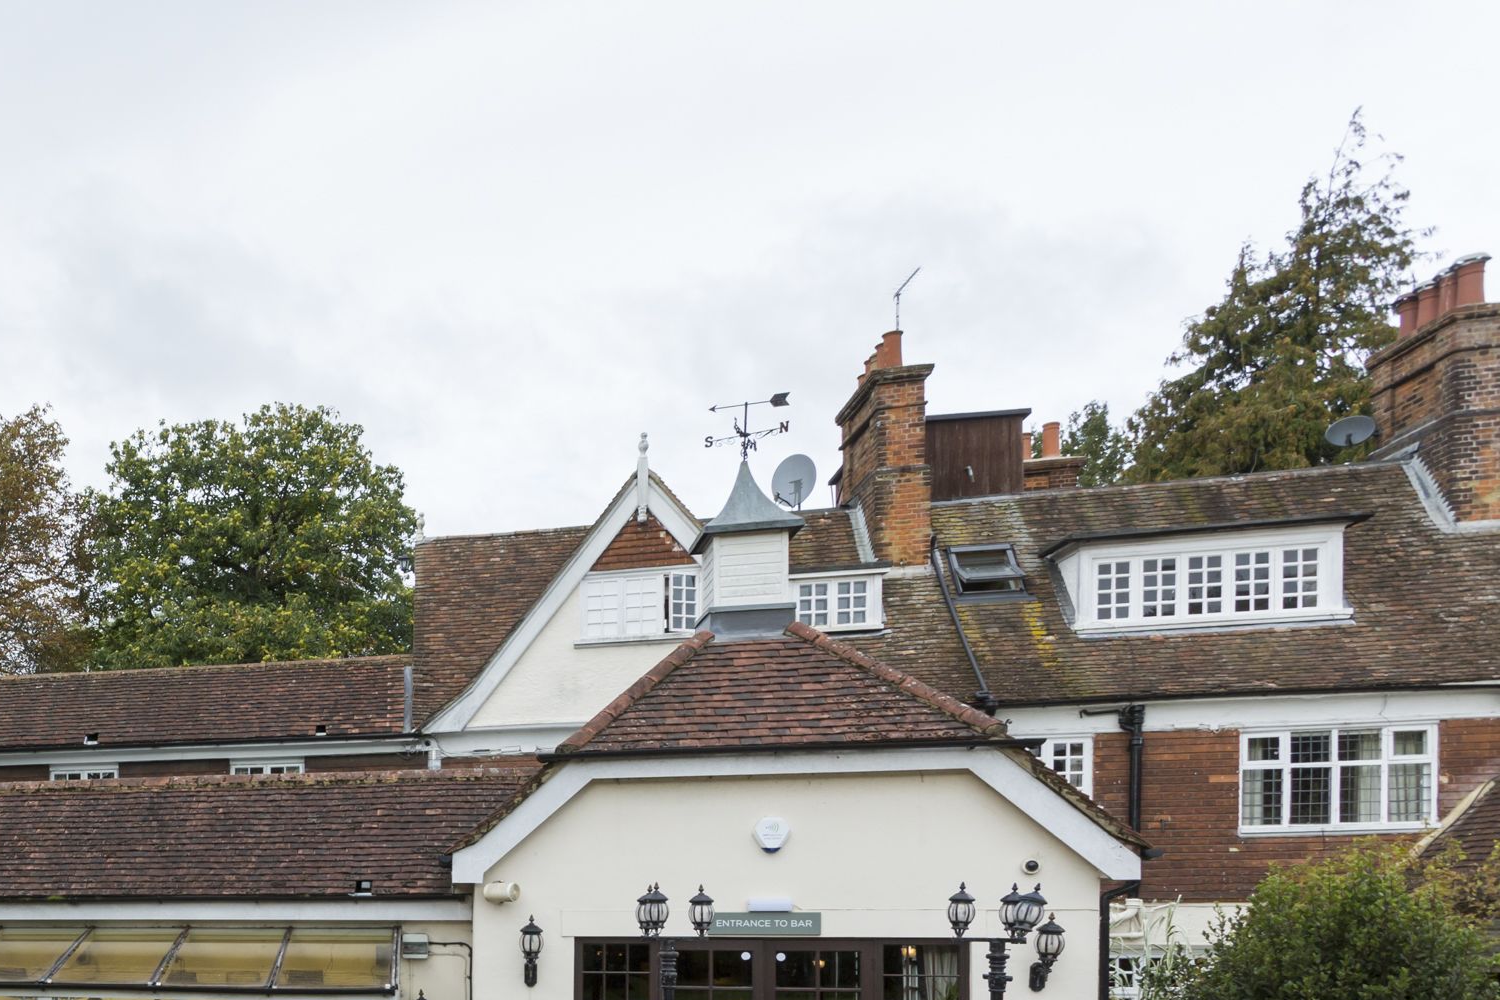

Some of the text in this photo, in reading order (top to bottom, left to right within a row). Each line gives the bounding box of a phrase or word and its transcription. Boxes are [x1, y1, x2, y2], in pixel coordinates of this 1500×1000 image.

[715, 919, 813, 928] ENTRANCE TO BAR
